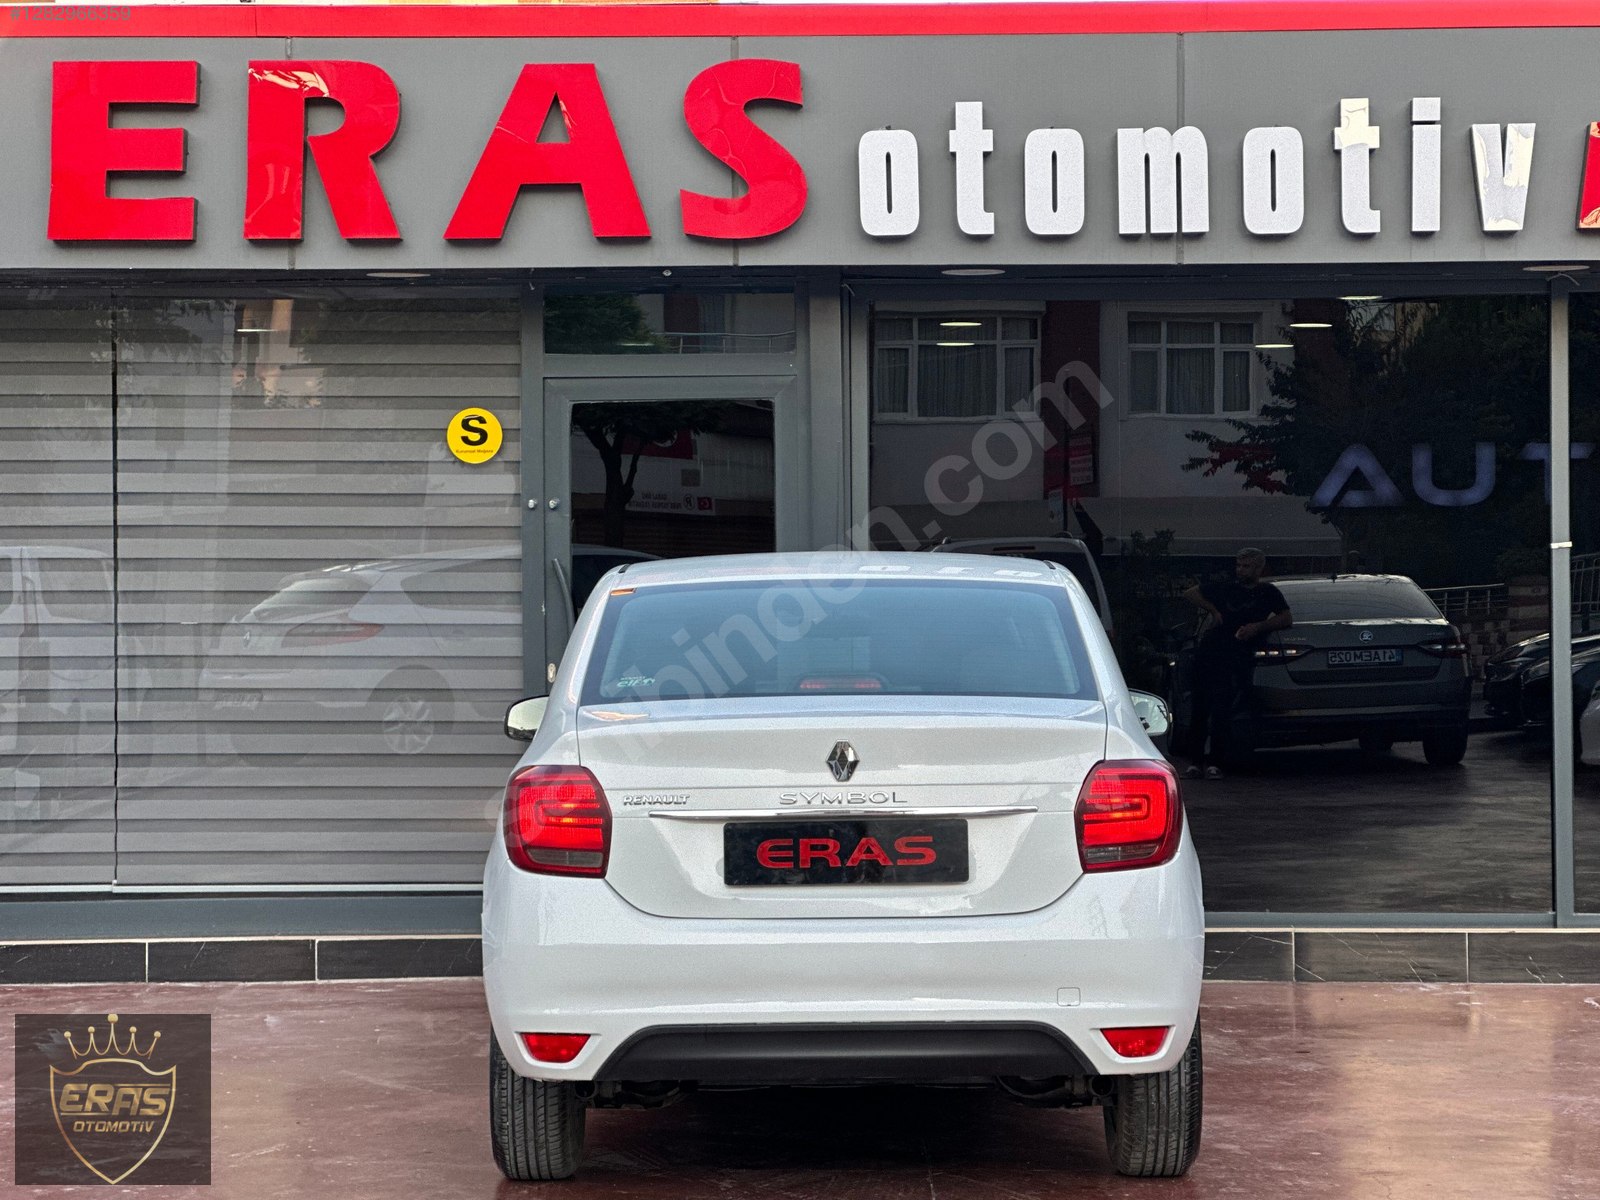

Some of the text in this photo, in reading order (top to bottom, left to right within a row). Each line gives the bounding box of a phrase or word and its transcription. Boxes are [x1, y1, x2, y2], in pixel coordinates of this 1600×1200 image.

[48, 59, 808, 242] ERAS
[858, 97, 1536, 237] otomotiv
[461, 414, 488, 446] S
[623, 795, 690, 806] RENAULT
[779, 791, 907, 805] SYMBOL
[756, 835, 936, 869] ERAS
